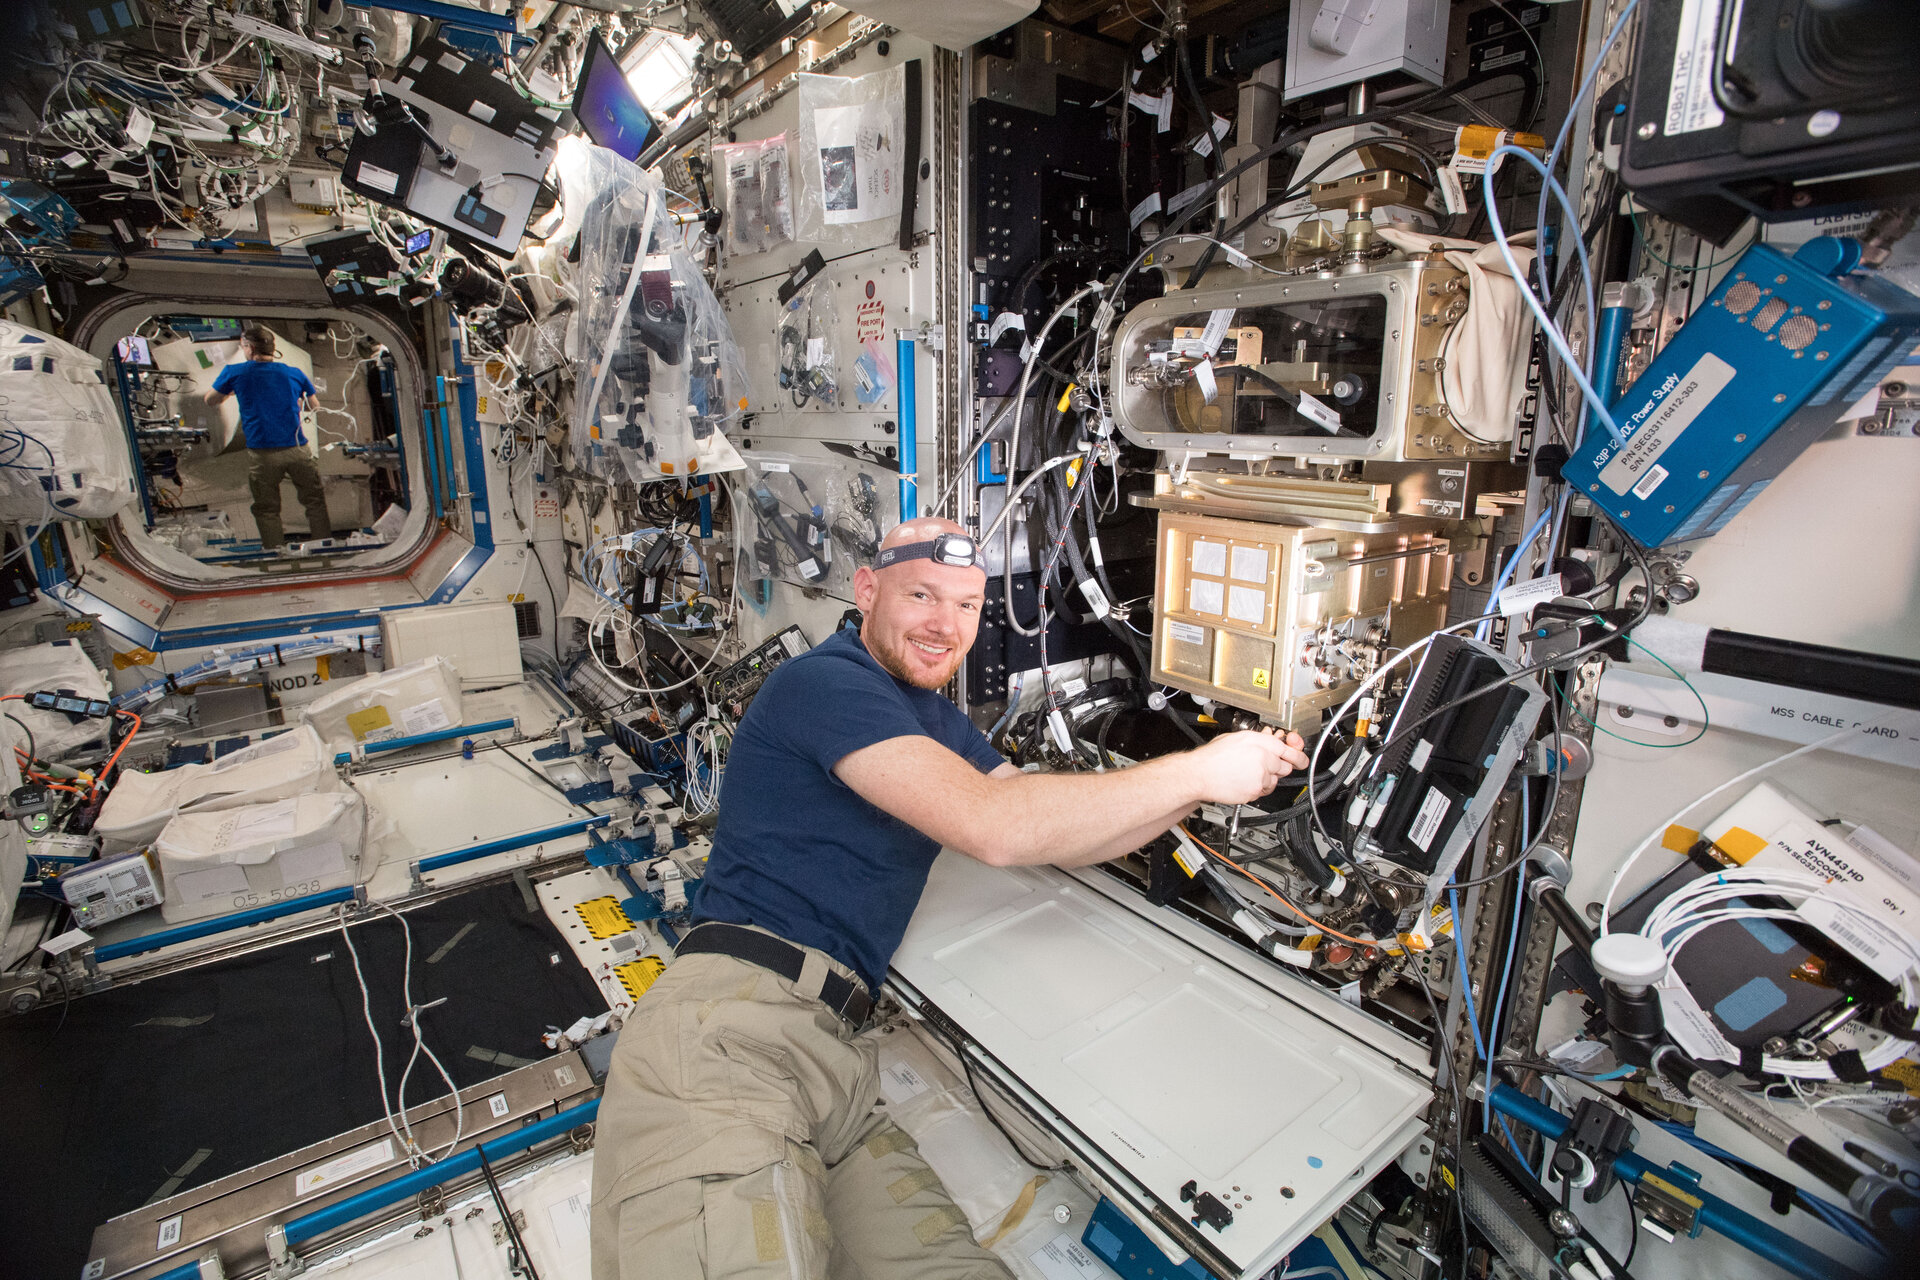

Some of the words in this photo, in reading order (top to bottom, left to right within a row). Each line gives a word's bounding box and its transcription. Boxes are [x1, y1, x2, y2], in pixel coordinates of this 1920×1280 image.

[1668, 85, 1685, 132] ROBoT
[1677, 51, 1691, 79] THC
[860, 319, 870, 327] FIRE
[869, 318, 881, 326] PORT
[1631, 399, 1655, 424] Power
[1652, 372, 1680, 399] Supply
[1621, 450, 1636, 466] P/N
[1634, 381, 1699, 452] SEG33116412-303
[1629, 457, 1645, 472] S/N
[1643, 438, 1662, 458] 1433
[270, 675, 307, 692] NOD
[312, 673, 322, 686] 2
[1771, 705, 1795, 719] MSS
[1802, 712, 1845, 729] CABLE
[1777, 841, 1792, 853] P/N
[1806, 839, 1849, 871] AVN443
[1847, 868, 1864, 883] HD
[1804, 850, 1848, 884] Encoder
[1882, 898, 1900, 911] Qty
